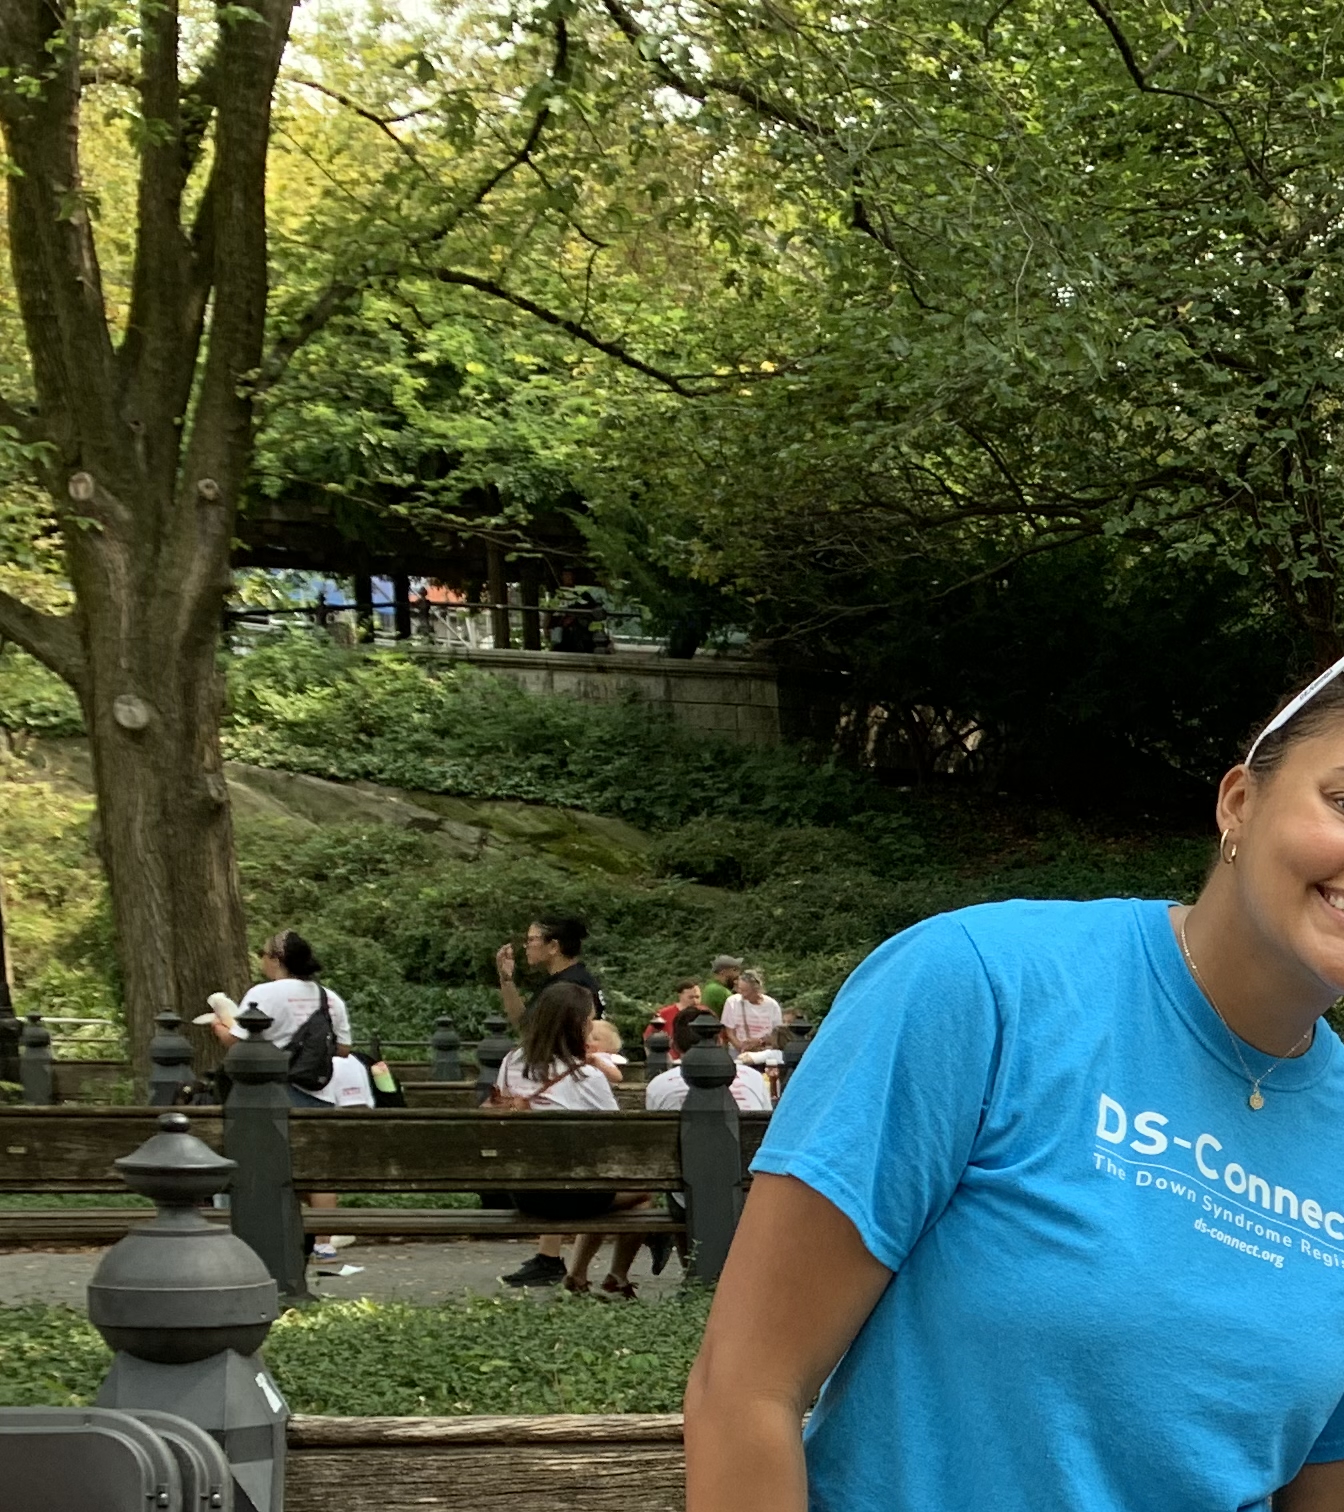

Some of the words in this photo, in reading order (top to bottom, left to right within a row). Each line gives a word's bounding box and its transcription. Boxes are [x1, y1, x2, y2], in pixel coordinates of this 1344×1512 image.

[1093, 1153, 1127, 1182] The
[1135, 1170, 1197, 1203] Down
[1201, 1195, 1293, 1248] Syndrome
[1194, 1217, 1285, 1269] ds-connect.org
